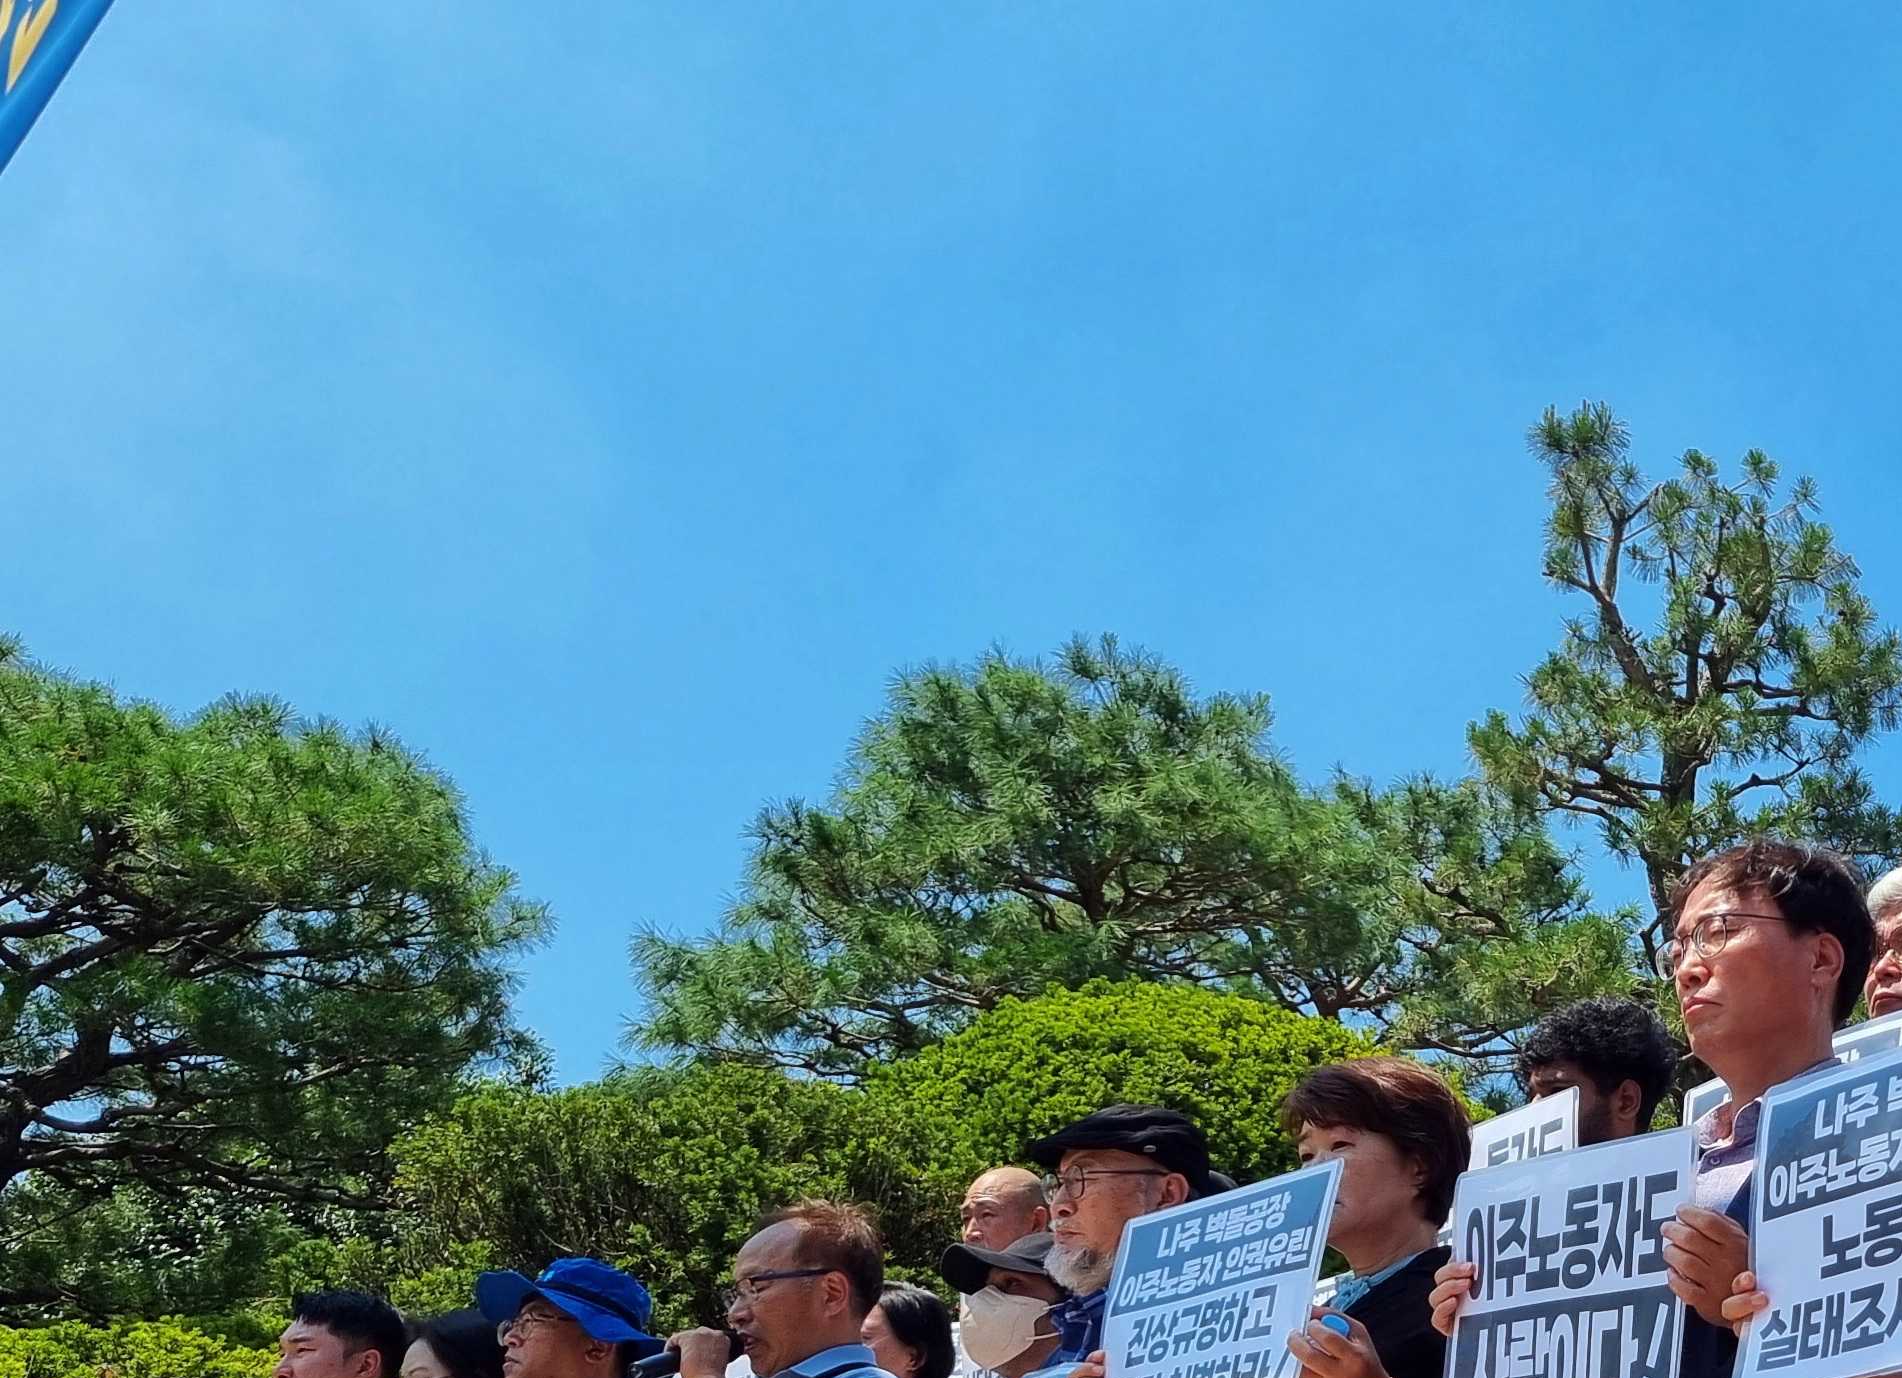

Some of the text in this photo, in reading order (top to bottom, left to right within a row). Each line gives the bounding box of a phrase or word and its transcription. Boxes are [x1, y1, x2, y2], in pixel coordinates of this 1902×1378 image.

[1814, 1081, 1879, 1140] 나주
[1157, 1191, 1292, 1258] 나주 벽돌공장
[1466, 1170, 1679, 1301] 이주노동자도
[1118, 1226, 1313, 1307] 이주노동자 인권유린
[1124, 1284, 1278, 1369] 진상규명하고
